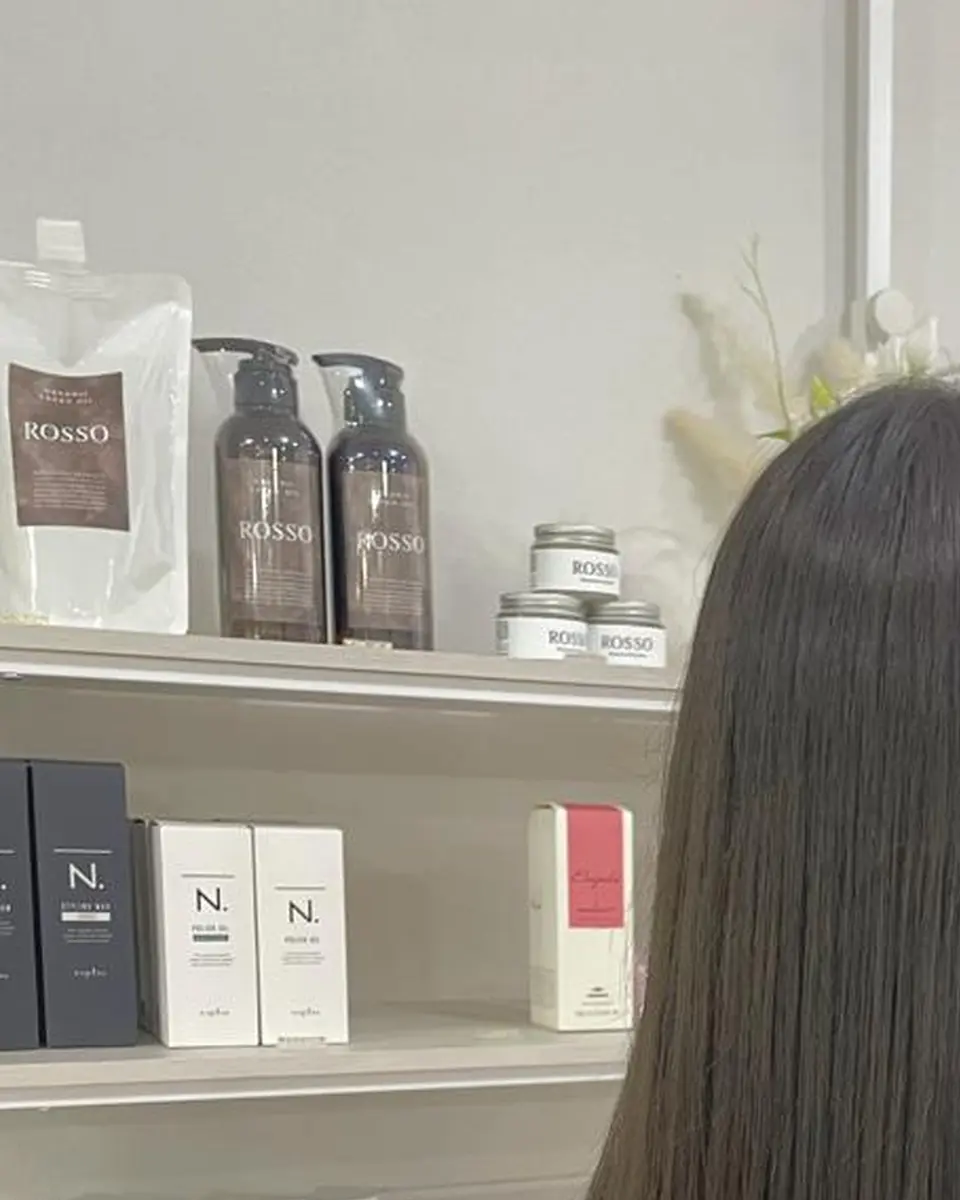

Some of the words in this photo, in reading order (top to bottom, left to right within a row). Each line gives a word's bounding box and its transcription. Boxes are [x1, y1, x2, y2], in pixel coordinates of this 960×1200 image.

[23, 420, 110, 445] ROSSO
[238, 519, 314, 545] ROSSO
[356, 529, 426, 556] ROSSO
[600, 634, 655, 652] ROSSO
[69, 862, 105, 890] N.
[195, 886, 229, 913] N.
[288, 898, 320, 924] N.
